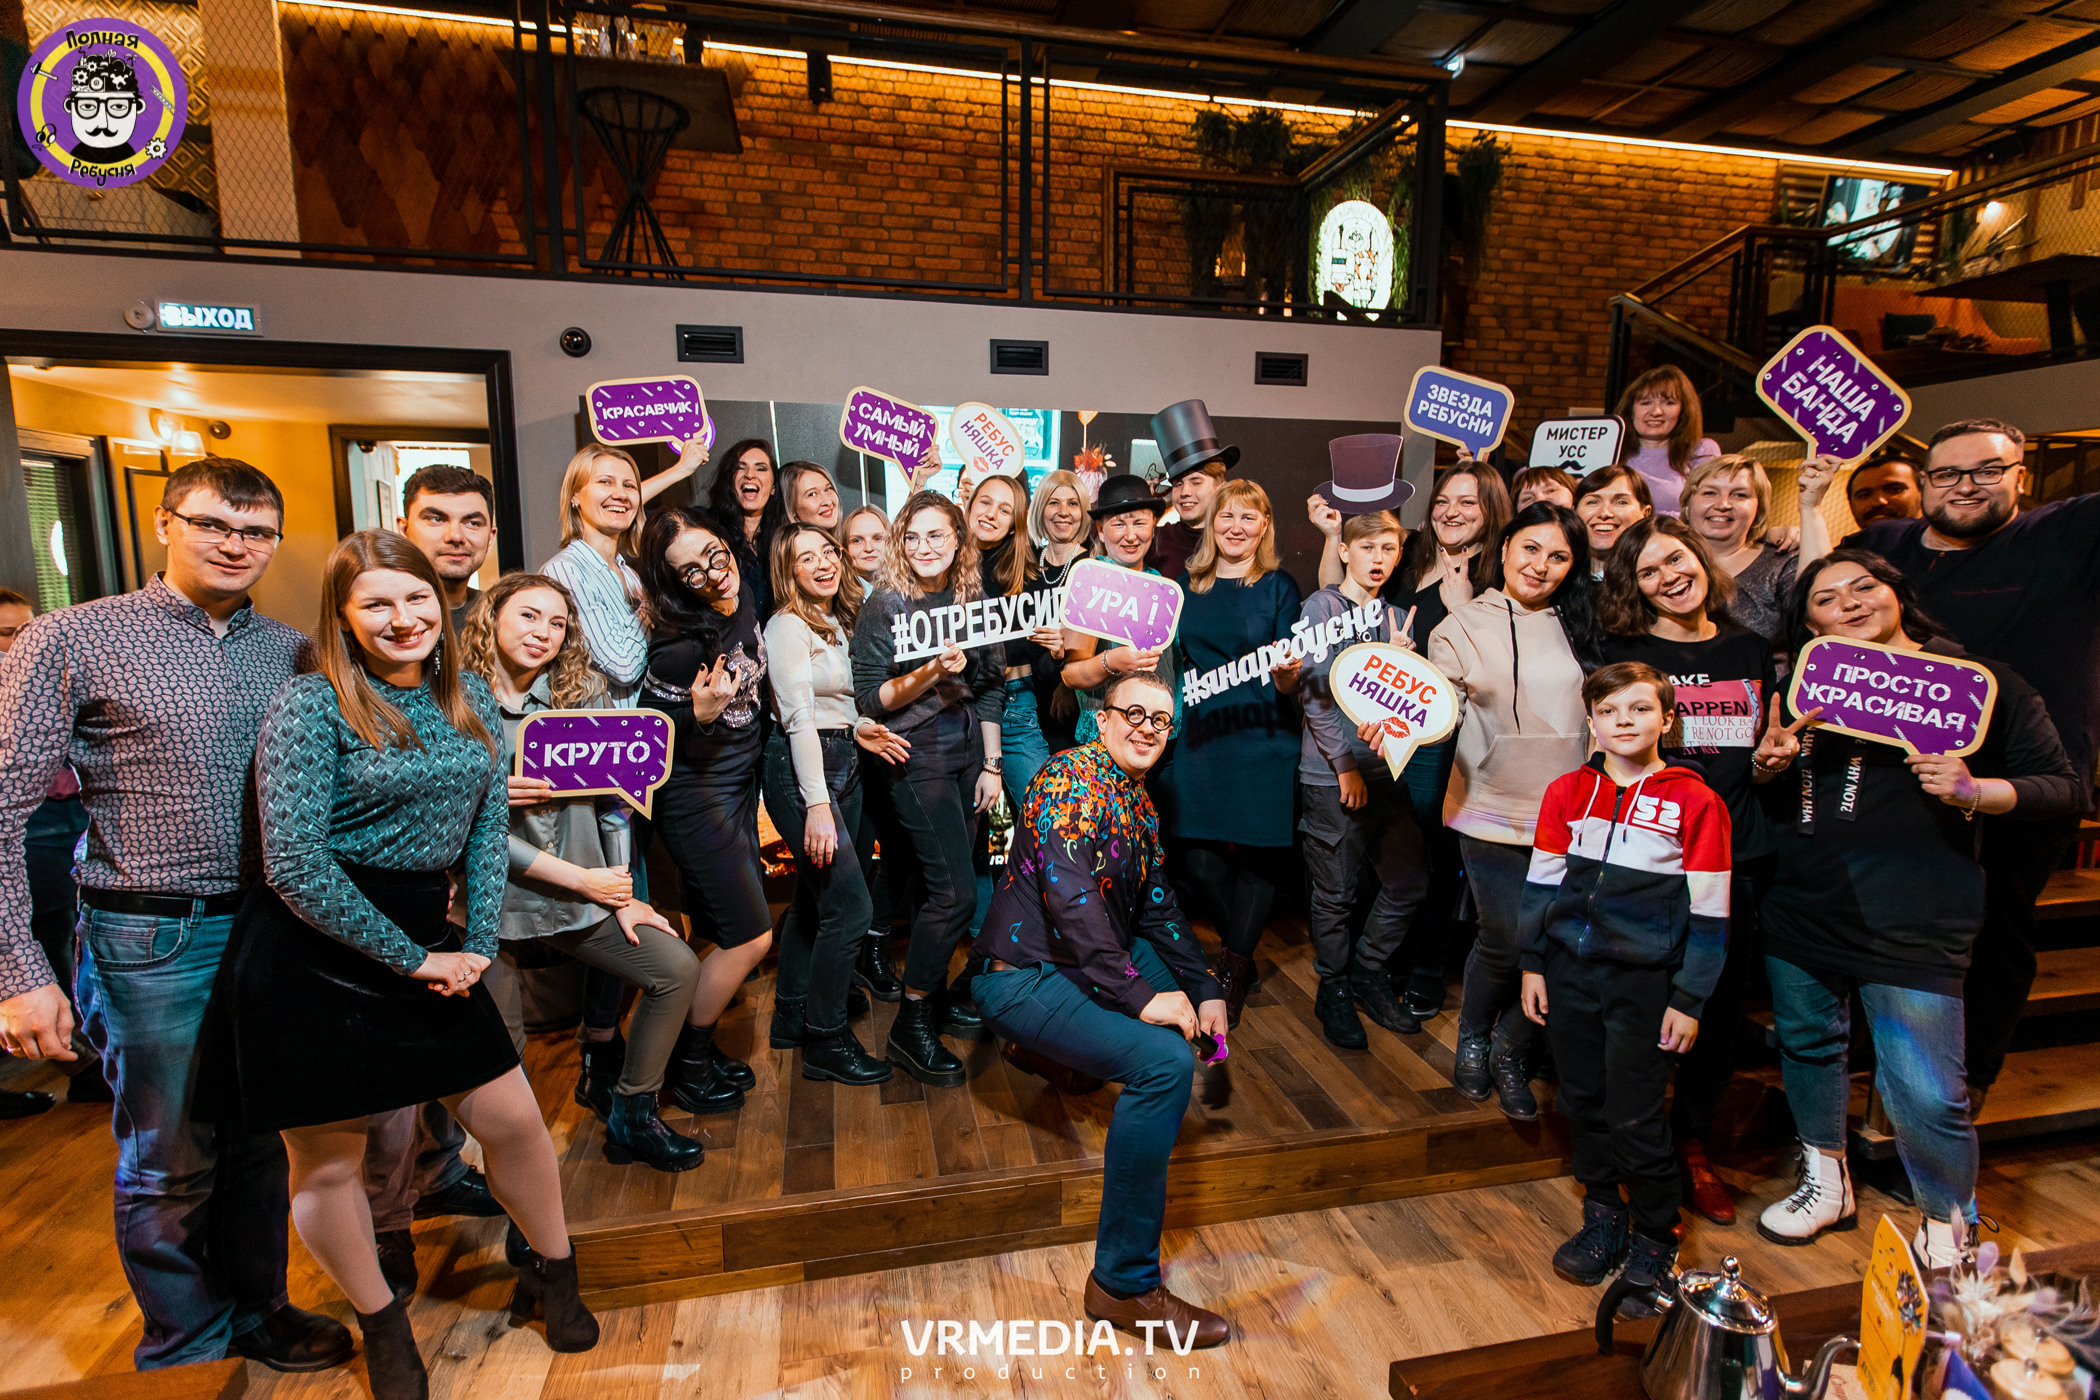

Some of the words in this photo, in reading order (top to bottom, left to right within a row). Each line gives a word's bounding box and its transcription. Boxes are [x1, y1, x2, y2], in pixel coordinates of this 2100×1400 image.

[163, 305, 254, 331] ВЫХОД
[1427, 384, 1493, 417] ЗВЕЗДА
[1806, 355, 1876, 422] НАША
[602, 401, 693, 420] КРАСАВЧИК
[858, 402, 926, 439] САМЫЙ
[1417, 400, 1494, 437] РЕБУСНИ
[1781, 370, 1859, 444] БАНДА
[854, 422, 920, 458] УМНЫЙ
[960, 420, 1004, 470] НЯШКА
[974, 412, 1015, 457] РЕБУС
[1546, 427, 1608, 441] МИСТЕР
[1559, 445, 1587, 458] УСС
[1182, 599, 1384, 707] #янаребусне
[1363, 654, 1437, 705] РЕБУС
[1668, 673, 1712, 688] AKE
[1832, 662, 1952, 702] ПРОСТО
[1348, 672, 1428, 727] НЯШКА
[1675, 701, 1748, 716] APPEN
[1807, 682, 1967, 733] КРАСИВАЯ
[1707, 727, 1732, 740] NOT
[544, 741, 651, 767] КРУТО
[1846, 756, 1862, 784] WHY
[1633, 795, 1681, 829] 52
[1802, 797, 1813, 823] WHY
[1840, 783, 1858, 813] NOT?
